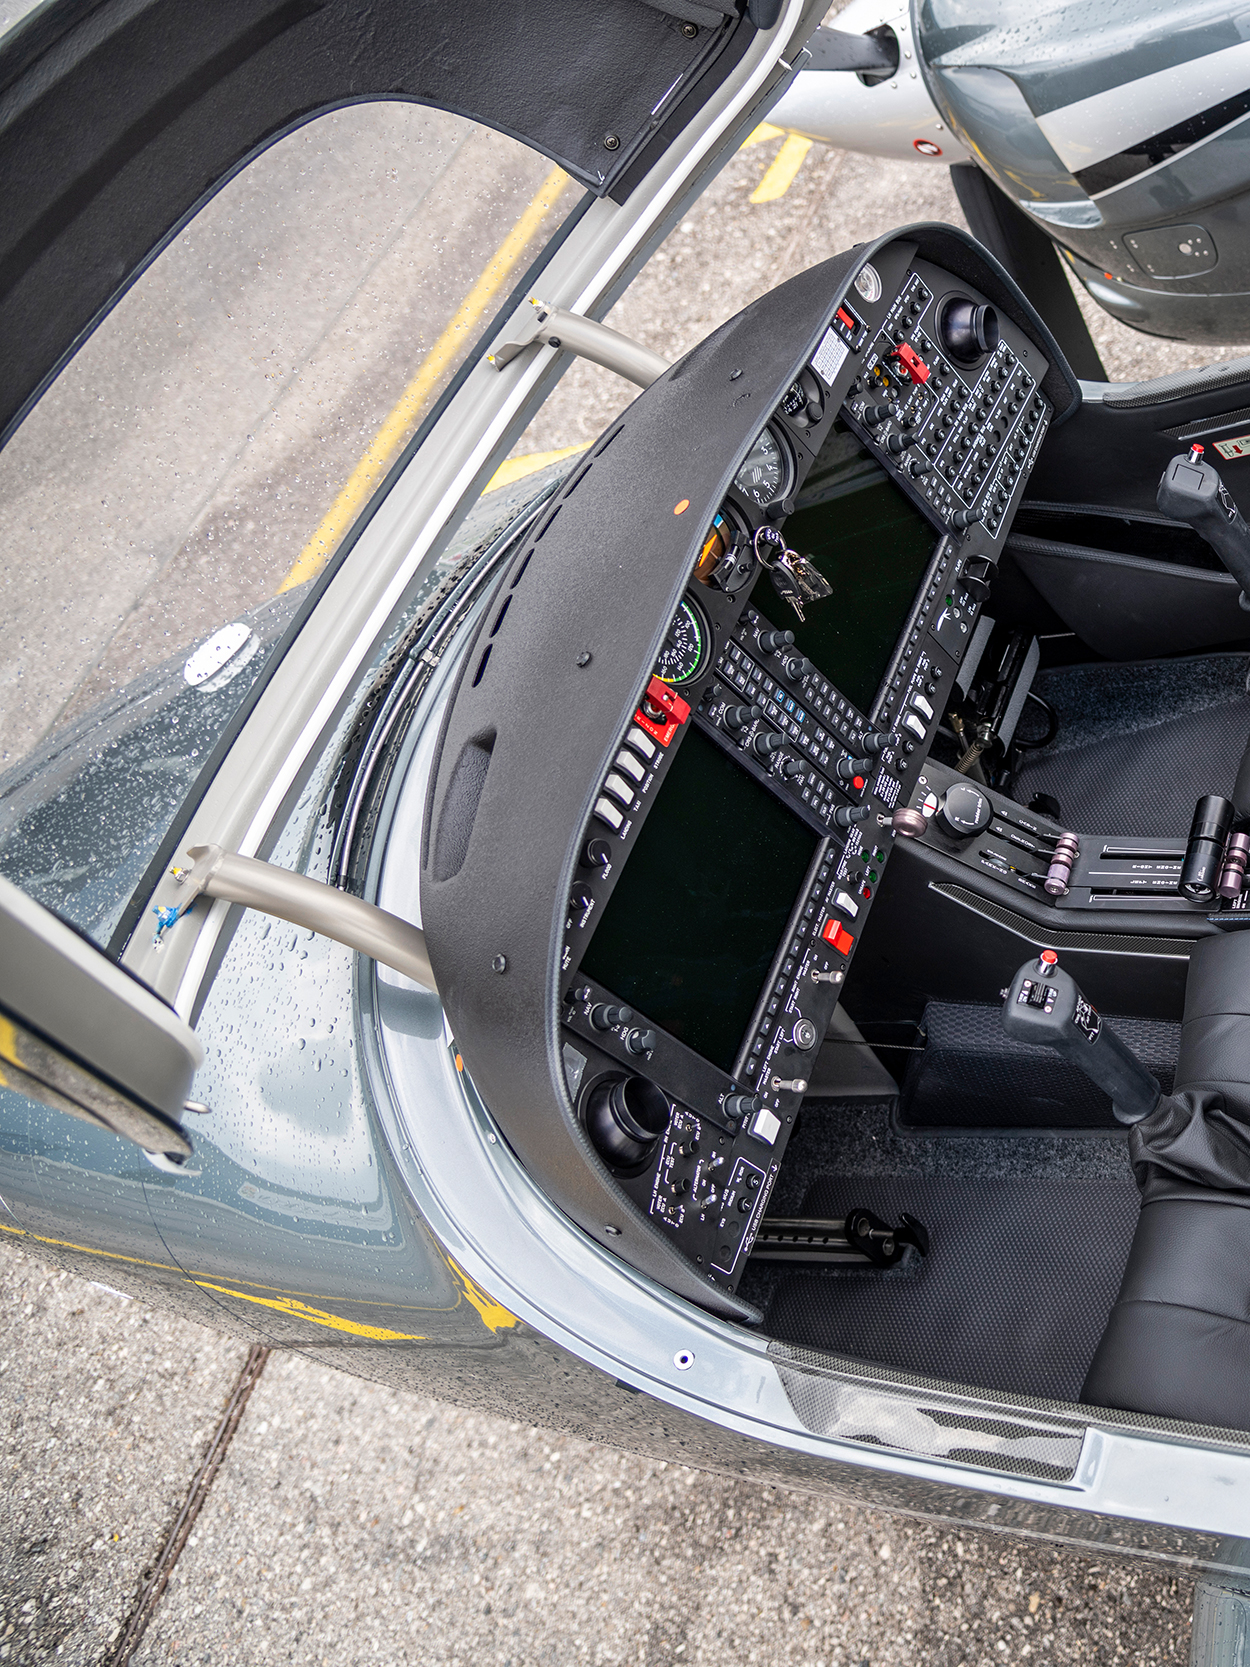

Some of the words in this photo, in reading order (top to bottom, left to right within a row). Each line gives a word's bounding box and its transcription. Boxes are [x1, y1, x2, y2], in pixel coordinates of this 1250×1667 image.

[761, 445, 770, 456] 3
[765, 463, 774, 471] 4
[762, 479, 770, 489] 5
[741, 487, 749, 497] 7
[753, 489, 760, 498] 6
[781, 655, 789, 666] HDG
[653, 752, 664, 769] STROBE
[774, 751, 785, 769] RANGE
[642, 773, 654, 793] POSITION
[633, 800, 641, 812] TAXI
[620, 820, 632, 840] LANDING
[602, 863, 612, 880] FLOOD
[858, 879, 866, 894] UNSAFE
[579, 899, 595, 928] INSTRUMENT
[562, 956, 571, 970] MUTE
[800, 960, 810, 976] MASTER
[583, 1002, 592, 1015] NAV
[620, 1027, 629, 1040] HDG
[766, 1045, 777, 1060] ENGINE
[762, 1067, 771, 1085] MASTER
[665, 1155, 673, 1165] ECU
[667, 1156, 675, 1168] TEST
[693, 1165, 701, 1193] ALTERNATOR
[751, 1219, 759, 1231] USB
[755, 1189, 769, 1219] CHARGING
[766, 1174, 774, 1190] PORT
